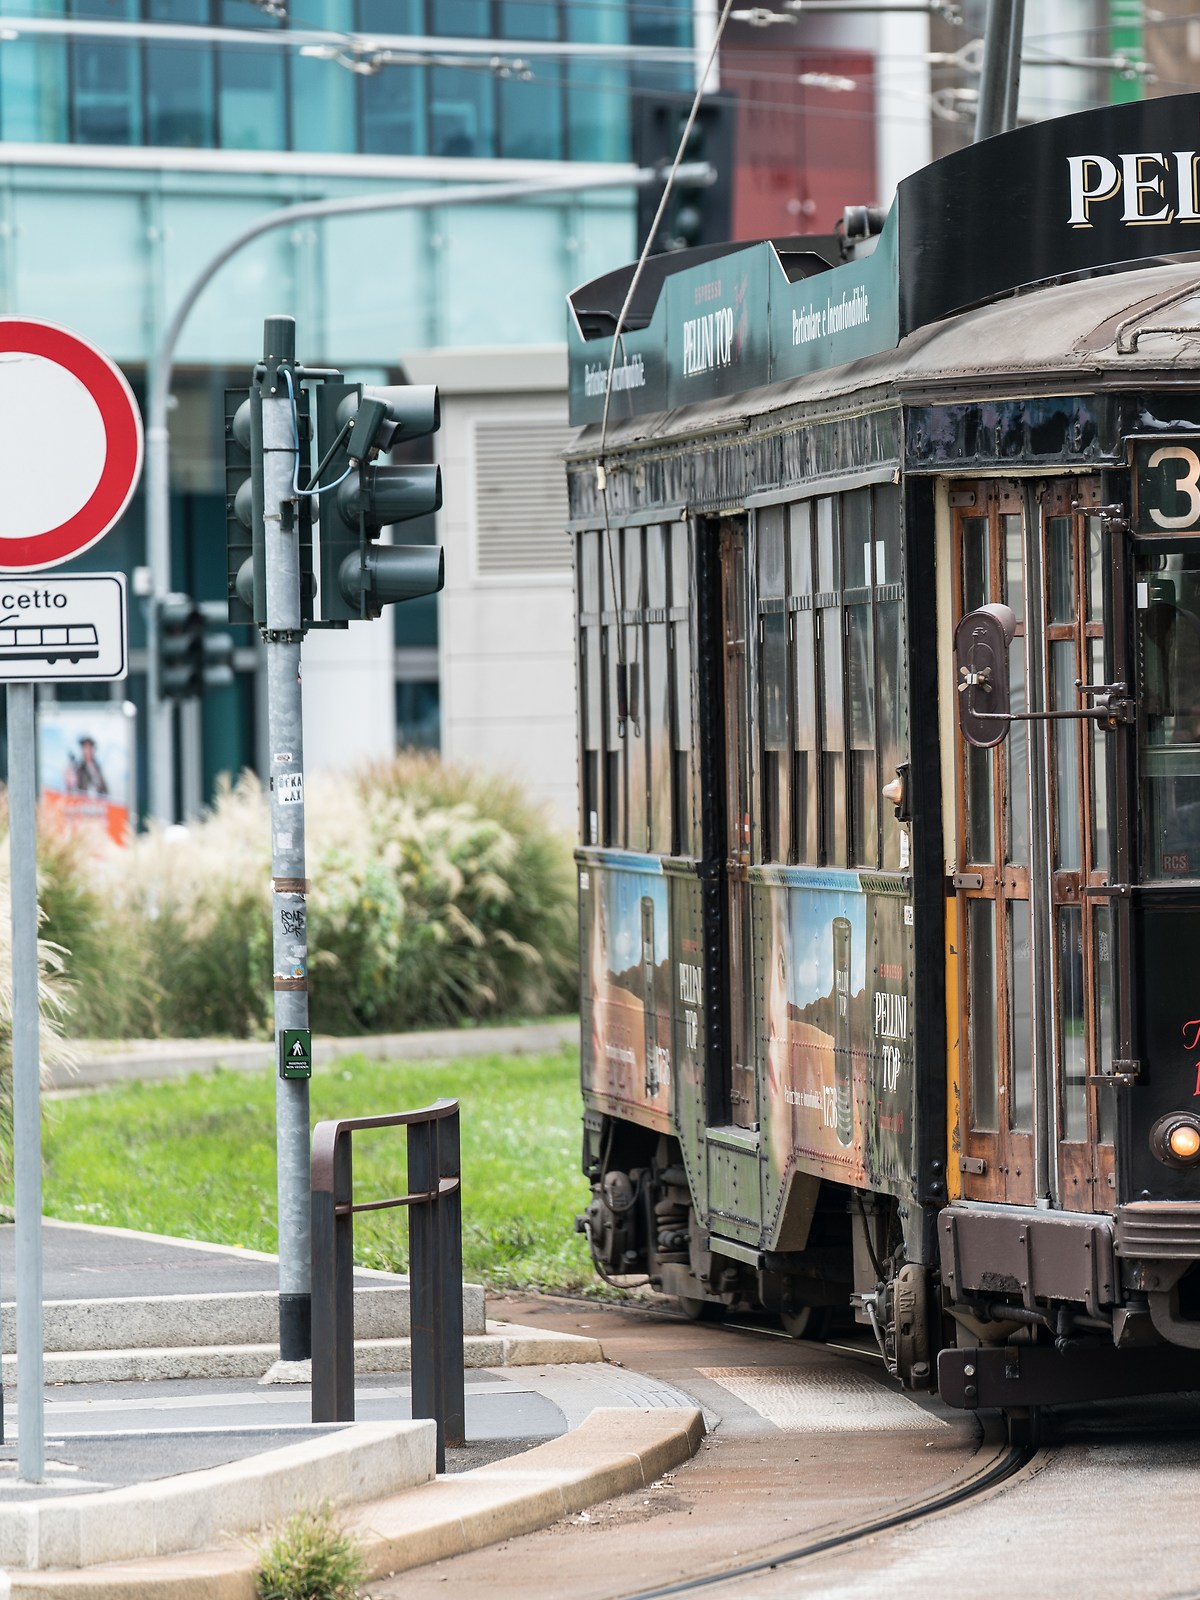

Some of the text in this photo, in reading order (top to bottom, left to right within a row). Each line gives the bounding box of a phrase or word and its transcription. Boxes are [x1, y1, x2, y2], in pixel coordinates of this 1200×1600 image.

[683, 312, 714, 378] PELLINI
[715, 307, 733, 369] TOP
[2, 590, 67, 610] cetto
[1164, 855, 1187, 869] RCS
[874, 991, 908, 1042] PELLINI
[882, 1045, 901, 1093] TOP
